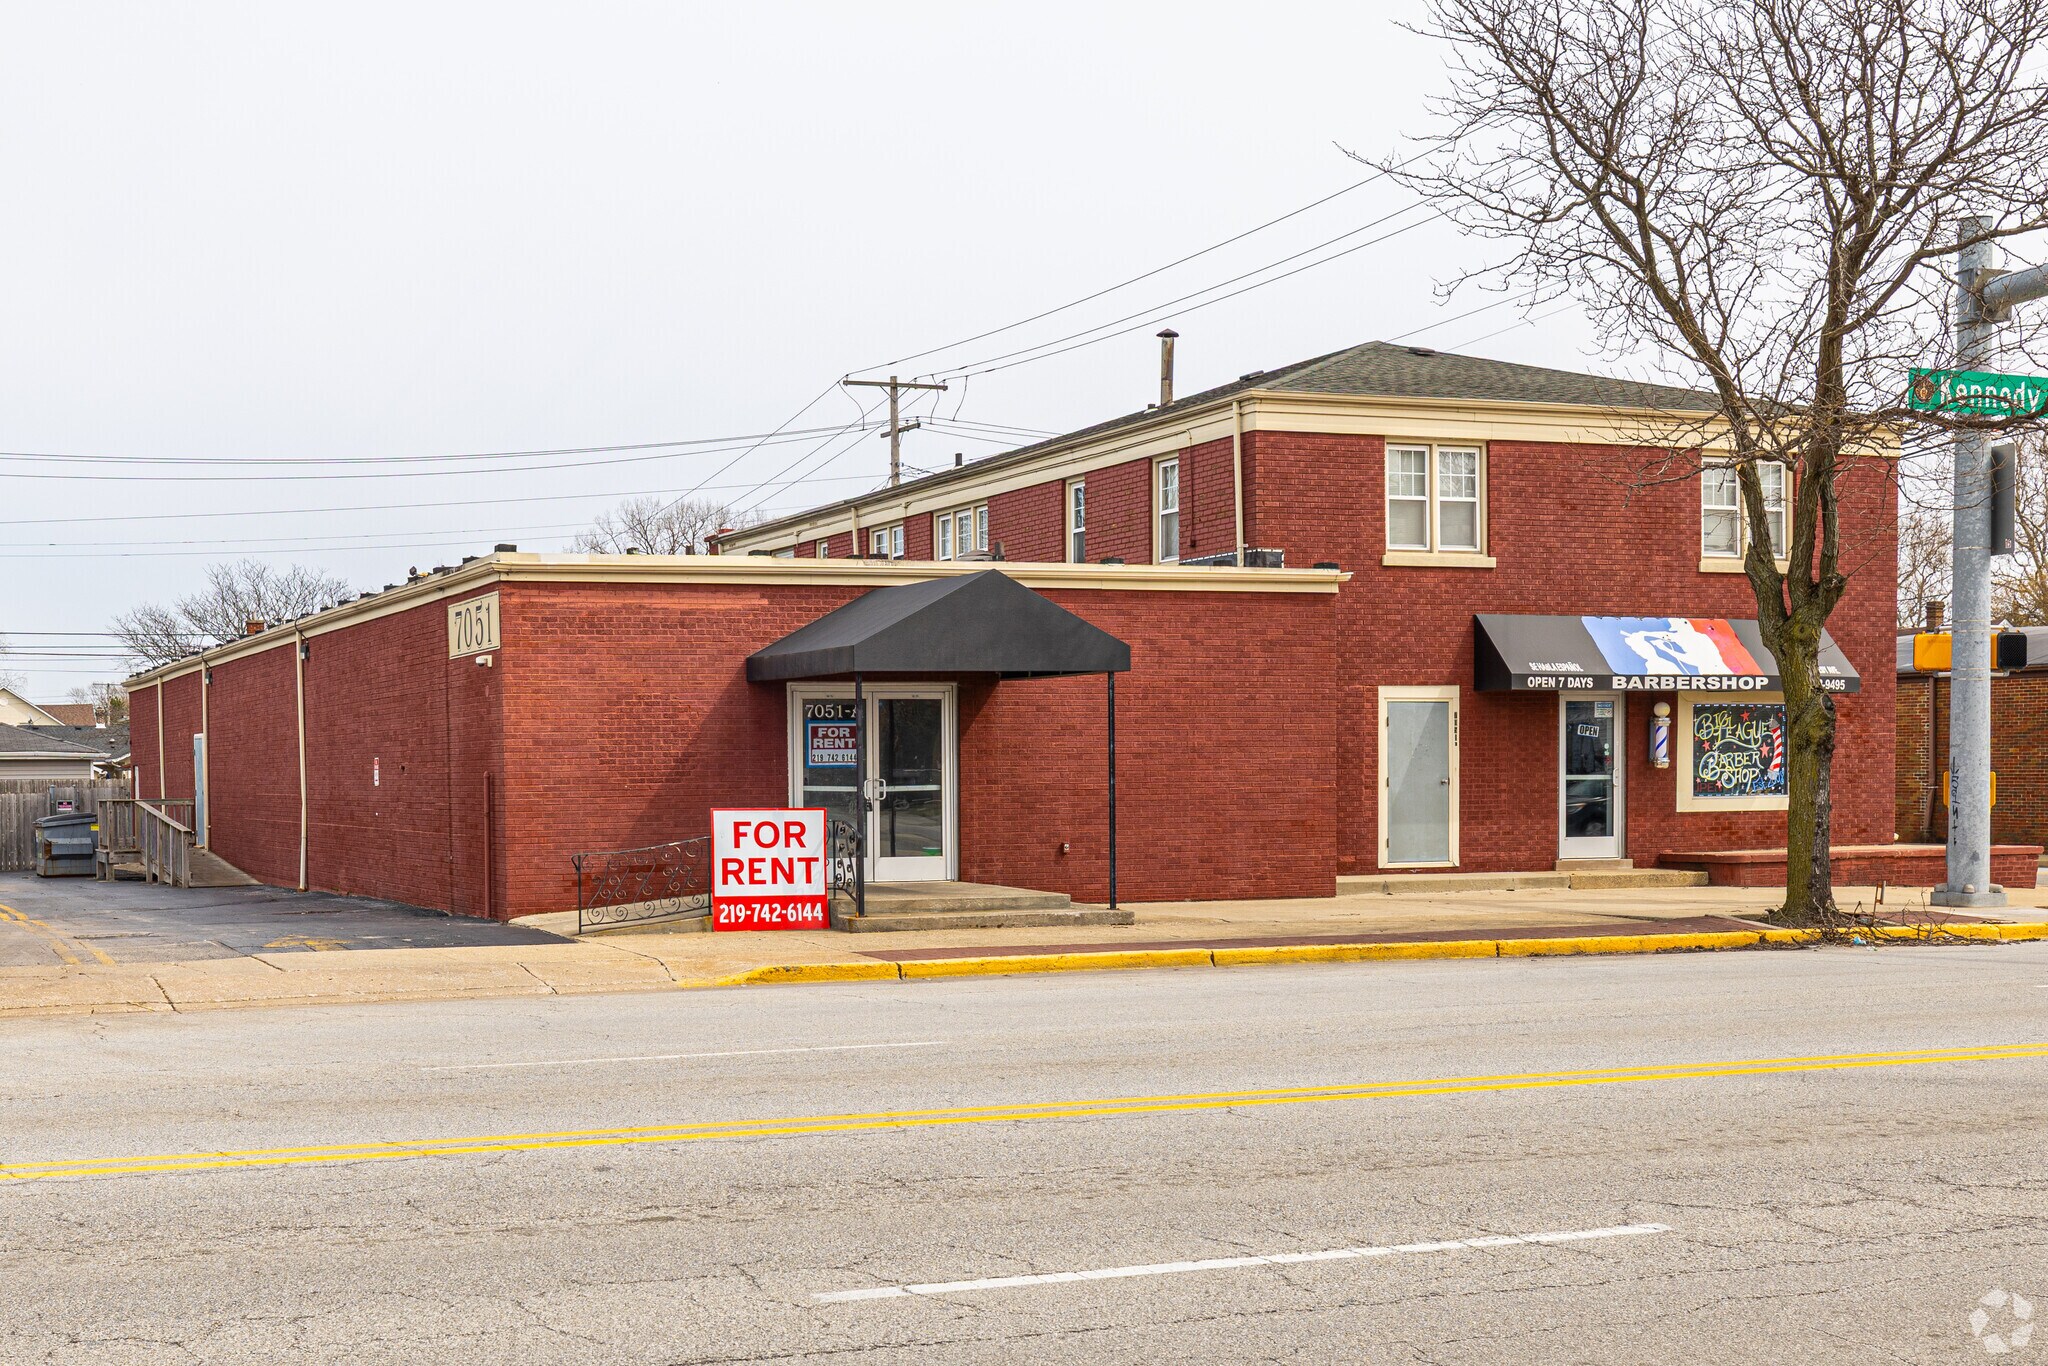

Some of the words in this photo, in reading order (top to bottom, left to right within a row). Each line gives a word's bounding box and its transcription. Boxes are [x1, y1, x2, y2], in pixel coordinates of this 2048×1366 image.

[1941, 375, 2041, 412] Kennedy
[454, 601, 492, 650] 7051
[1527, 676, 1556, 688] OPEN
[1558, 676, 1565, 688] 7
[1567, 677, 1594, 689] DAYS
[1612, 676, 1769, 690] BARBERSHOP
[818, 728, 850, 737] FOR
[1580, 725, 1599, 736] OPEN
[813, 738, 856, 748] RENT
[812, 754, 824, 762] 219
[827, 754, 839, 762] 742
[1699, 751, 1765, 781] BARBER
[1721, 766, 1761, 793] SHOP
[733, 821, 806, 848] FOR
[722, 857, 819, 885] RENT
[719, 903, 823, 923] 219-742-6144
